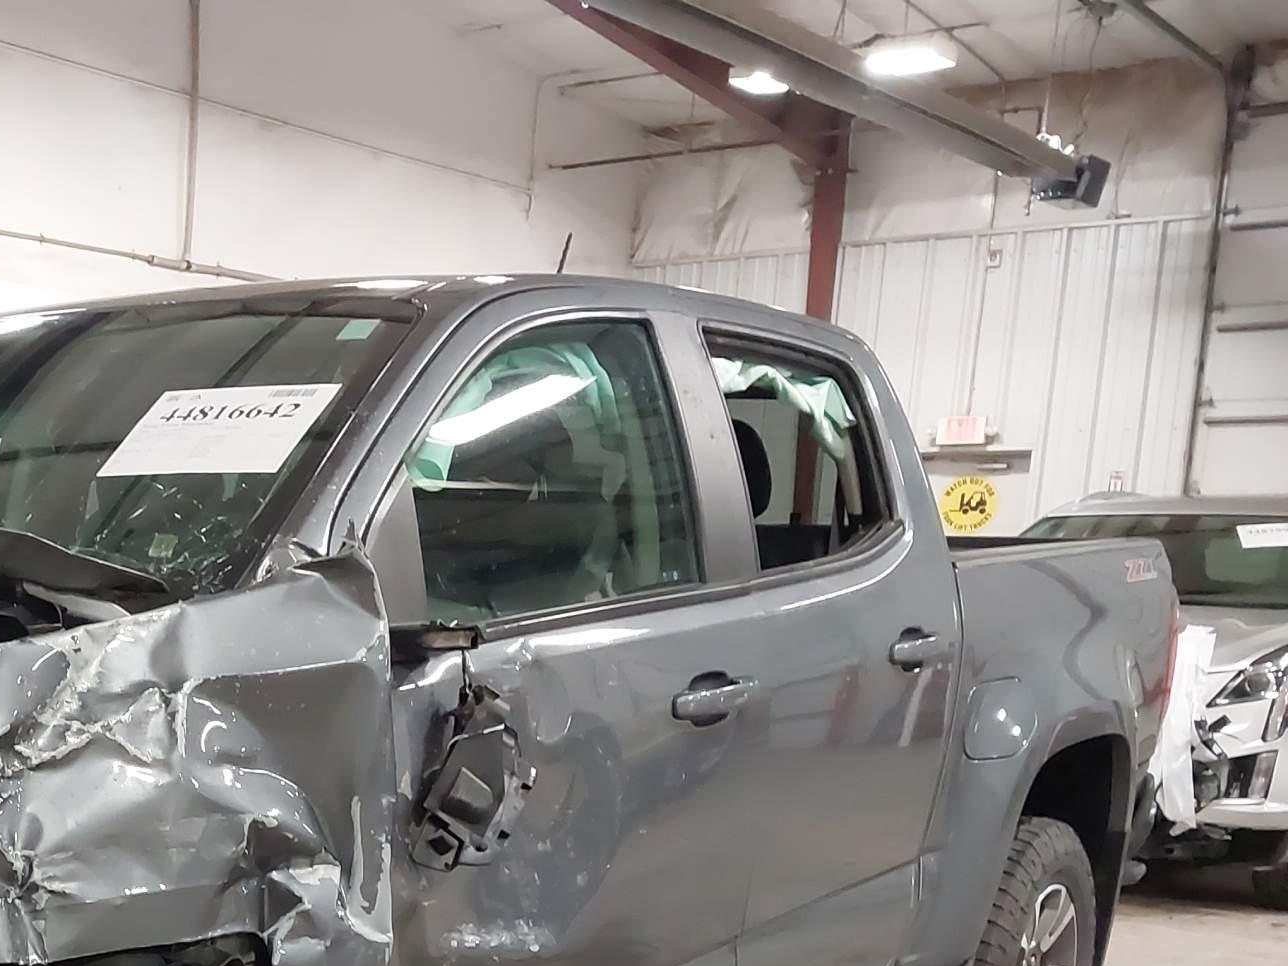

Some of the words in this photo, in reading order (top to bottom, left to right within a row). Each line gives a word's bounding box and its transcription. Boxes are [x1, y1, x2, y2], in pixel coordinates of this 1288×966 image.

[160, 402, 302, 423] 44816642
[944, 478, 968, 496] WATCH
[969, 478, 984, 486] OUT
[984, 484, 995, 496] FOR
[969, 513, 992, 531] TRUCKS
